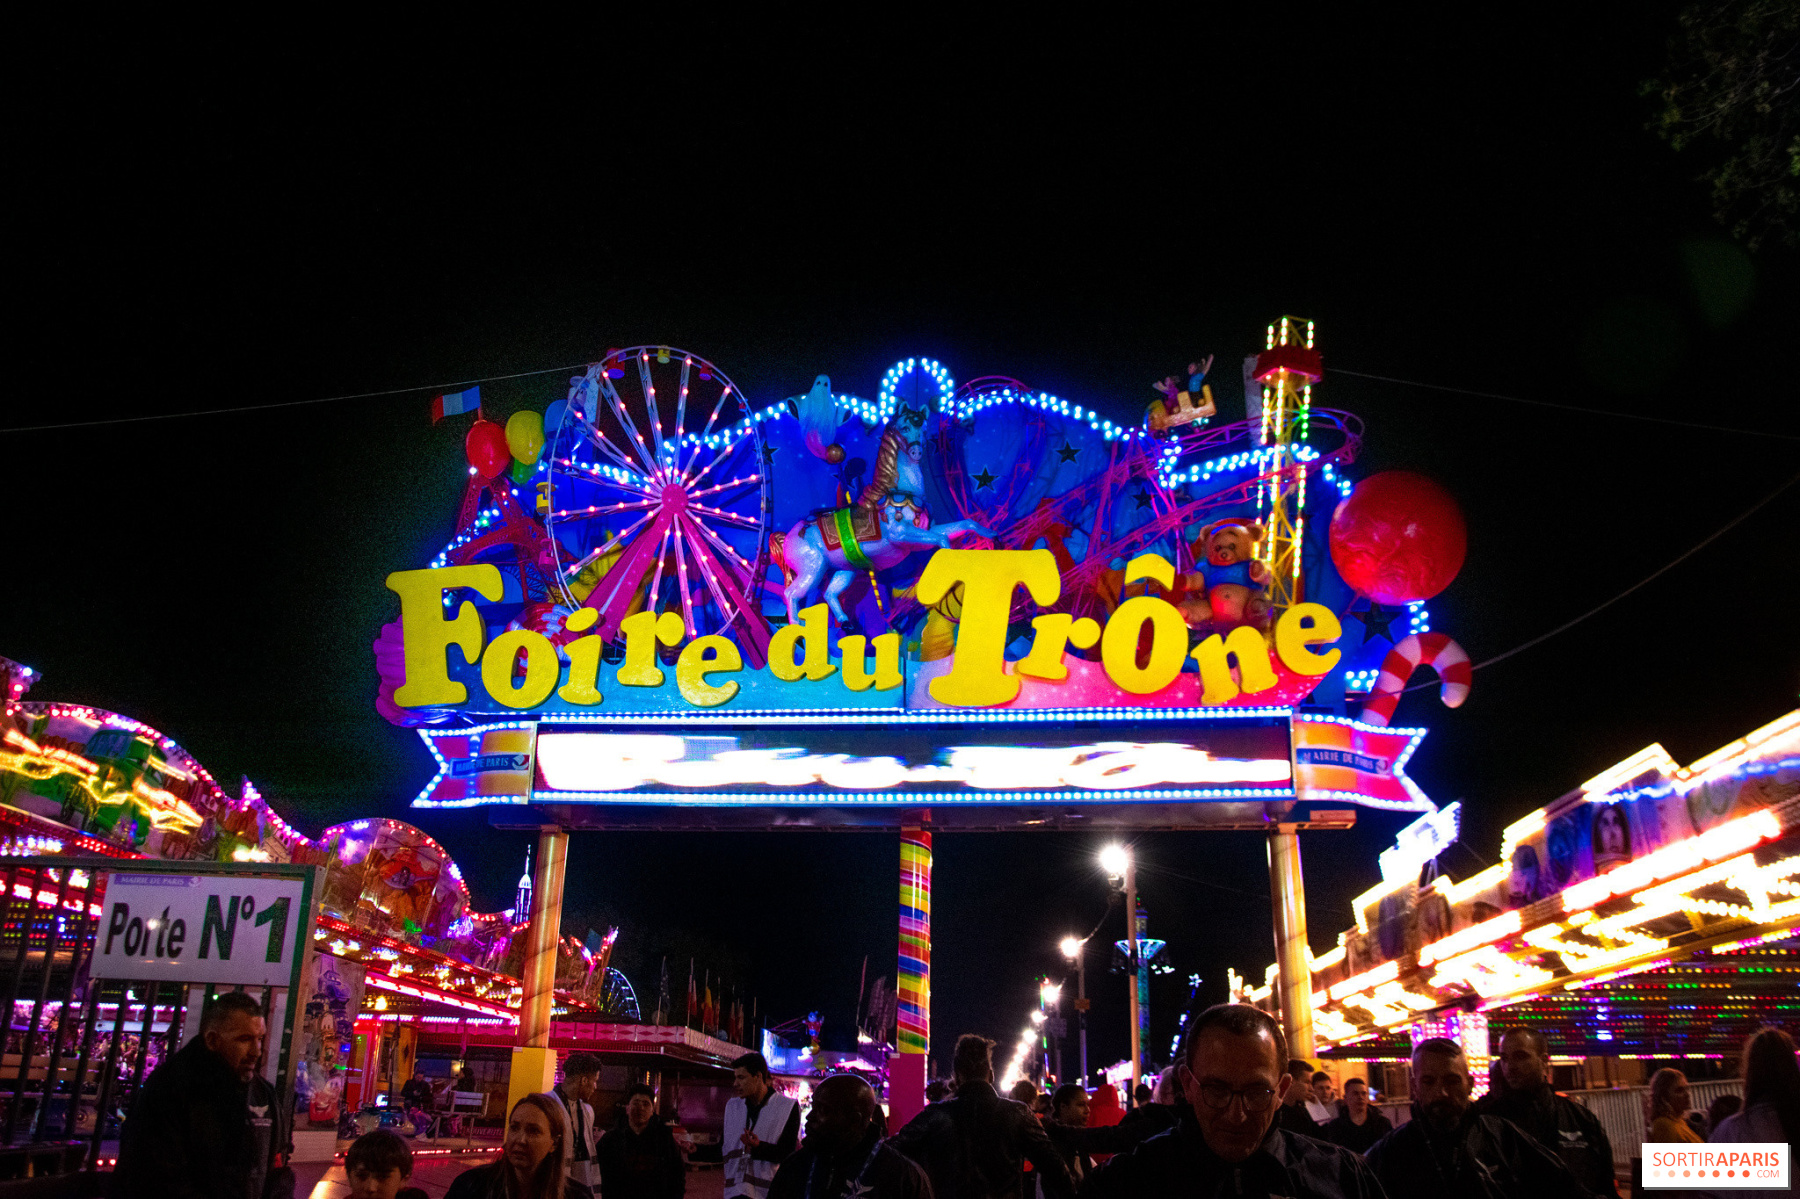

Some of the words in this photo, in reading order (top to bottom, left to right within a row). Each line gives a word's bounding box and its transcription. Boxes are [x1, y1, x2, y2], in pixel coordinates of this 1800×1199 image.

[386, 563, 742, 709] Foire
[768, 603, 903, 691] du
[917, 548, 1342, 707] Trône
[486, 757, 509, 767] PARIS
[1303, 751, 1339, 762] MAIRIE
[1342, 752, 1353, 764] DE
[121, 876, 148, 884] MAIRIE
[149, 877, 161, 885] DE
[162, 877, 185, 886] PARIS
[103, 902, 186, 958] Porte
